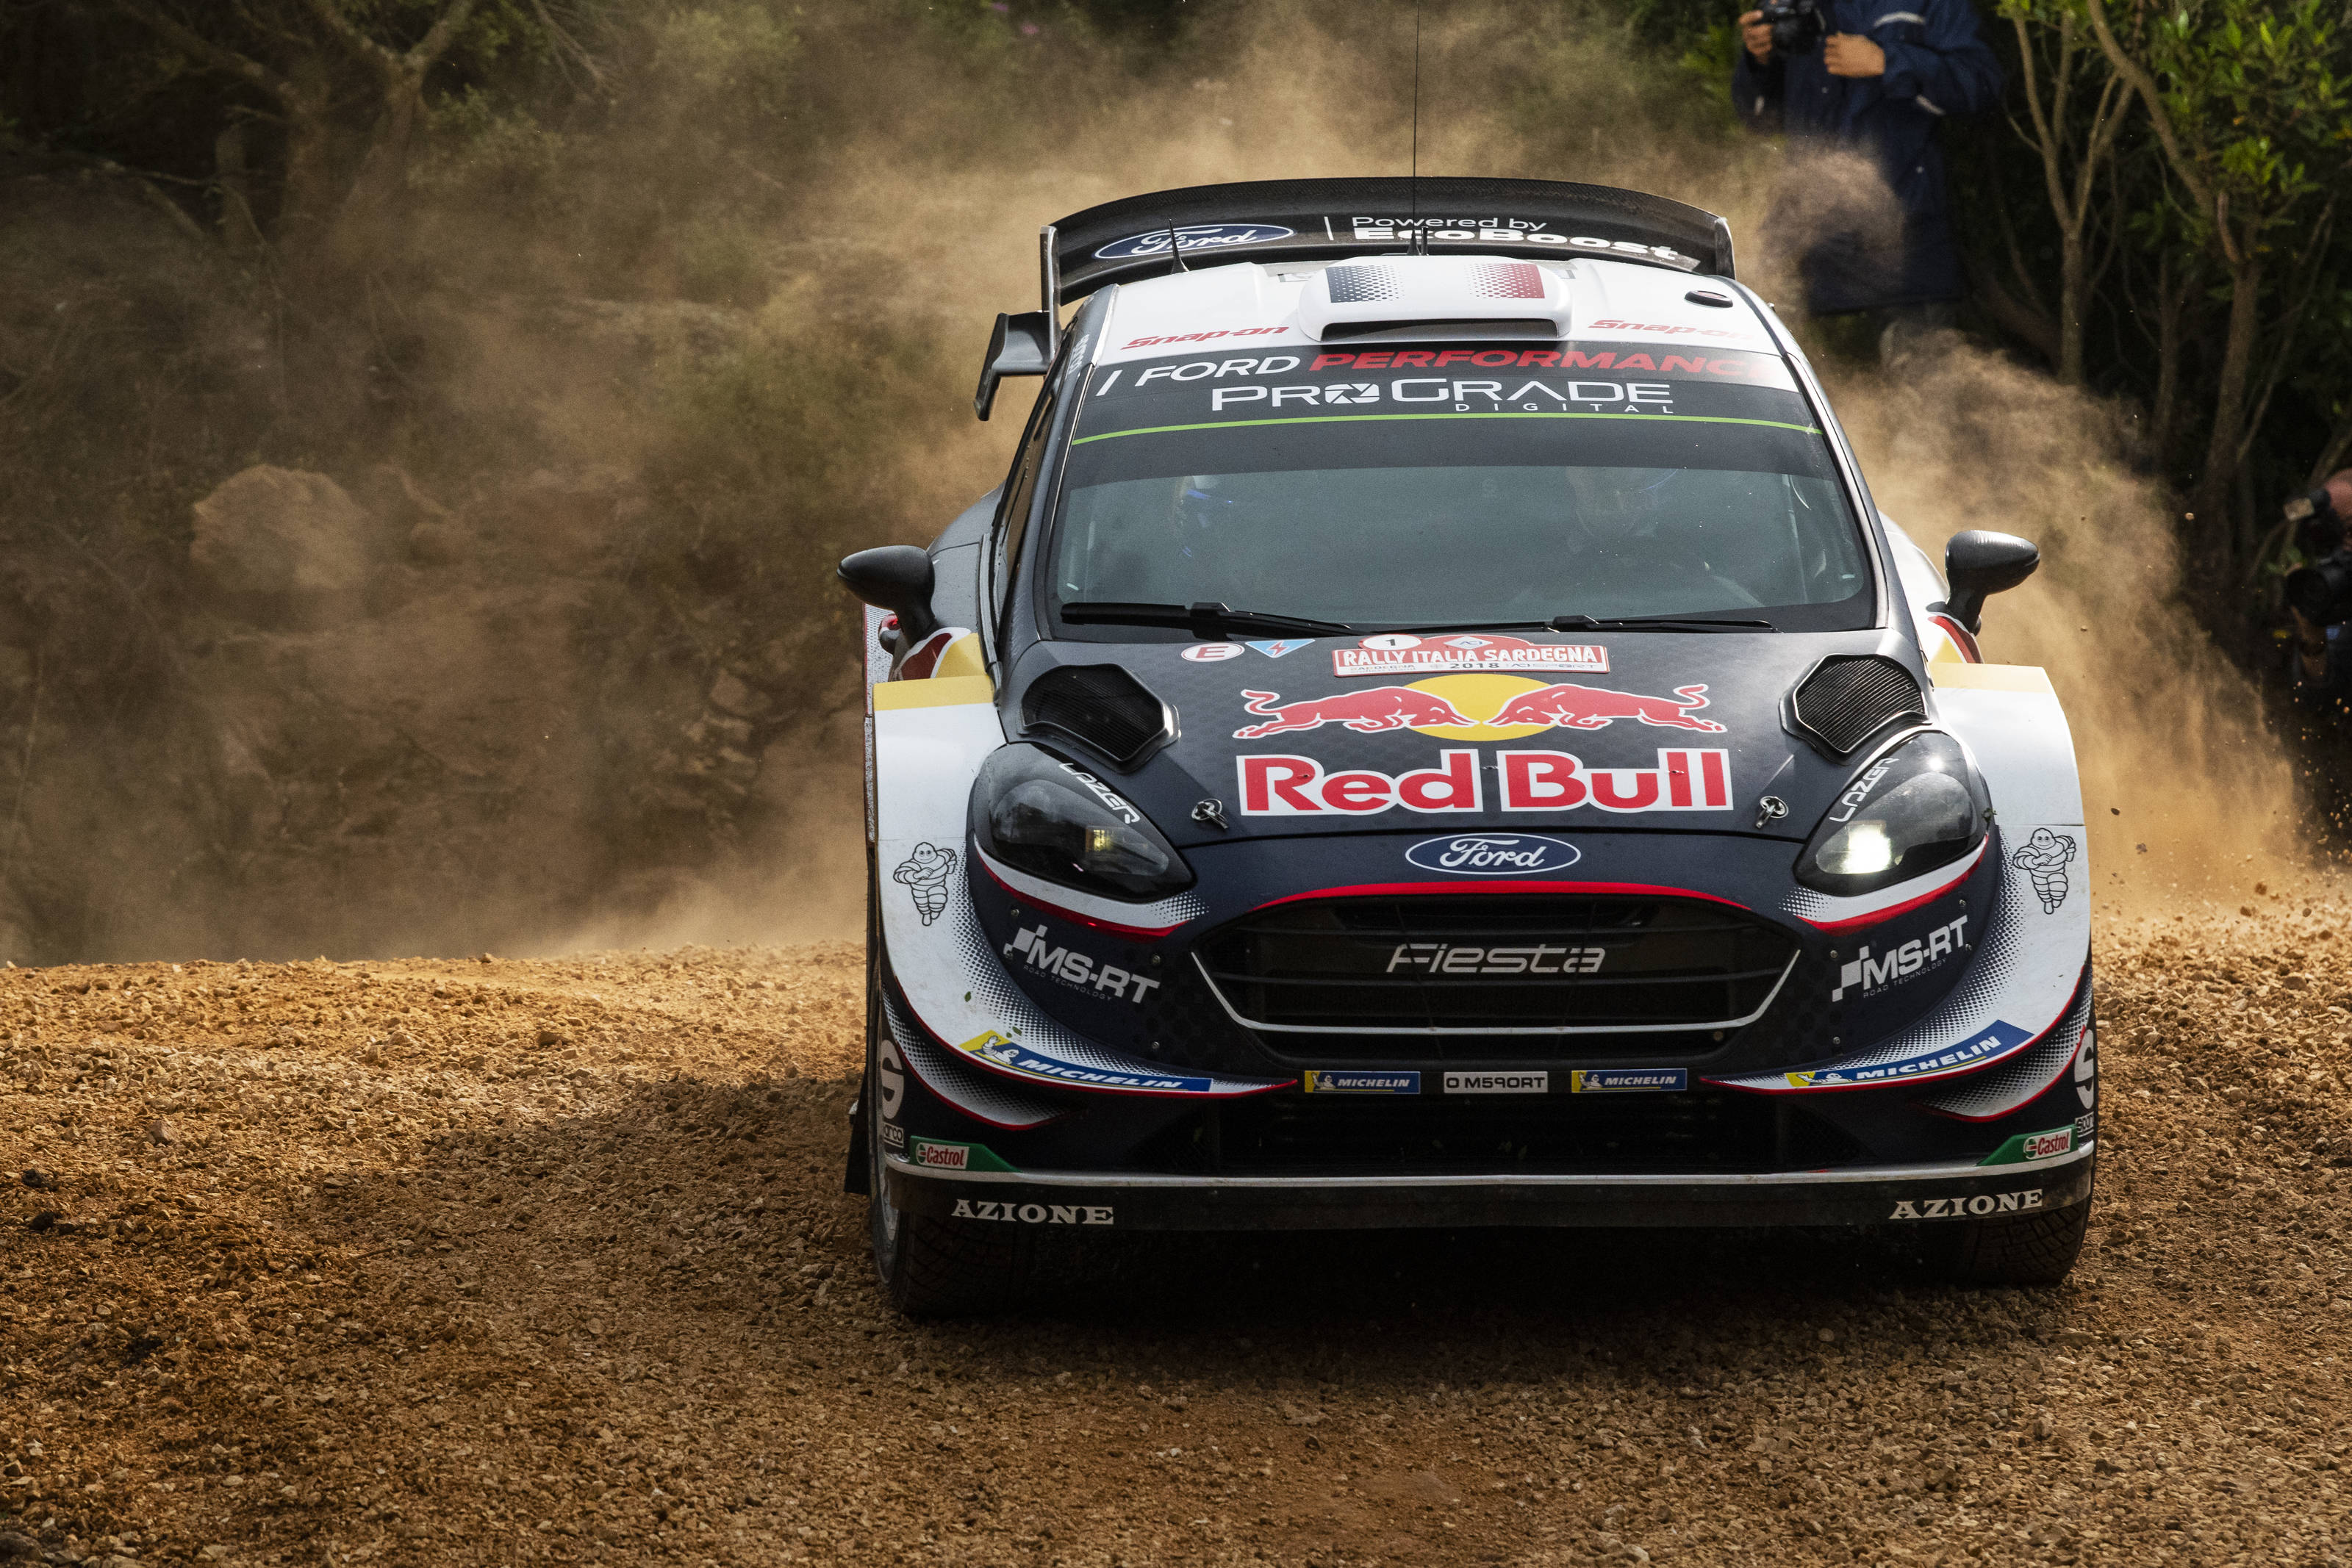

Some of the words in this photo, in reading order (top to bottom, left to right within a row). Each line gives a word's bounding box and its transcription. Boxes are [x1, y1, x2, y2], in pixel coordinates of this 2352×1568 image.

[1352, 217, 1498, 228] Powered
[1509, 217, 1547, 231] by
[1132, 228, 1258, 254] Ford
[1354, 227, 1679, 261] EcoBoost
[1121, 326, 1289, 350] Snap-on
[1134, 356, 1301, 387] FORD
[1455, 403, 1674, 414] DIGITAL
[1196, 646, 1229, 659] E
[1343, 650, 1406, 666] RALLY
[1412, 650, 1478, 663] ITALIA
[1483, 646, 1599, 663] SARDEGNA
[1385, 639, 1396, 647] 1
[1058, 762, 1141, 824] LAZER
[1244, 752, 1475, 812] Red
[1505, 752, 1727, 810] Bull
[1829, 758, 1899, 822] LAZER
[1440, 838, 1548, 868] Ford
[1385, 943, 1606, 974] Fiesta
[1856, 1035, 2002, 1079] MICHELIN
[1016, 1057, 1182, 1089] MICHELIN
[1337, 1077, 1410, 1088] MICHELIN
[1605, 1075, 1677, 1087] MICHELIN
[926, 1146, 965, 1166] Castrol
[2037, 1132, 2070, 1156] Castrol
[951, 1198, 1114, 1226] AZIONE
[1888, 1188, 2044, 1220] AZIONE
